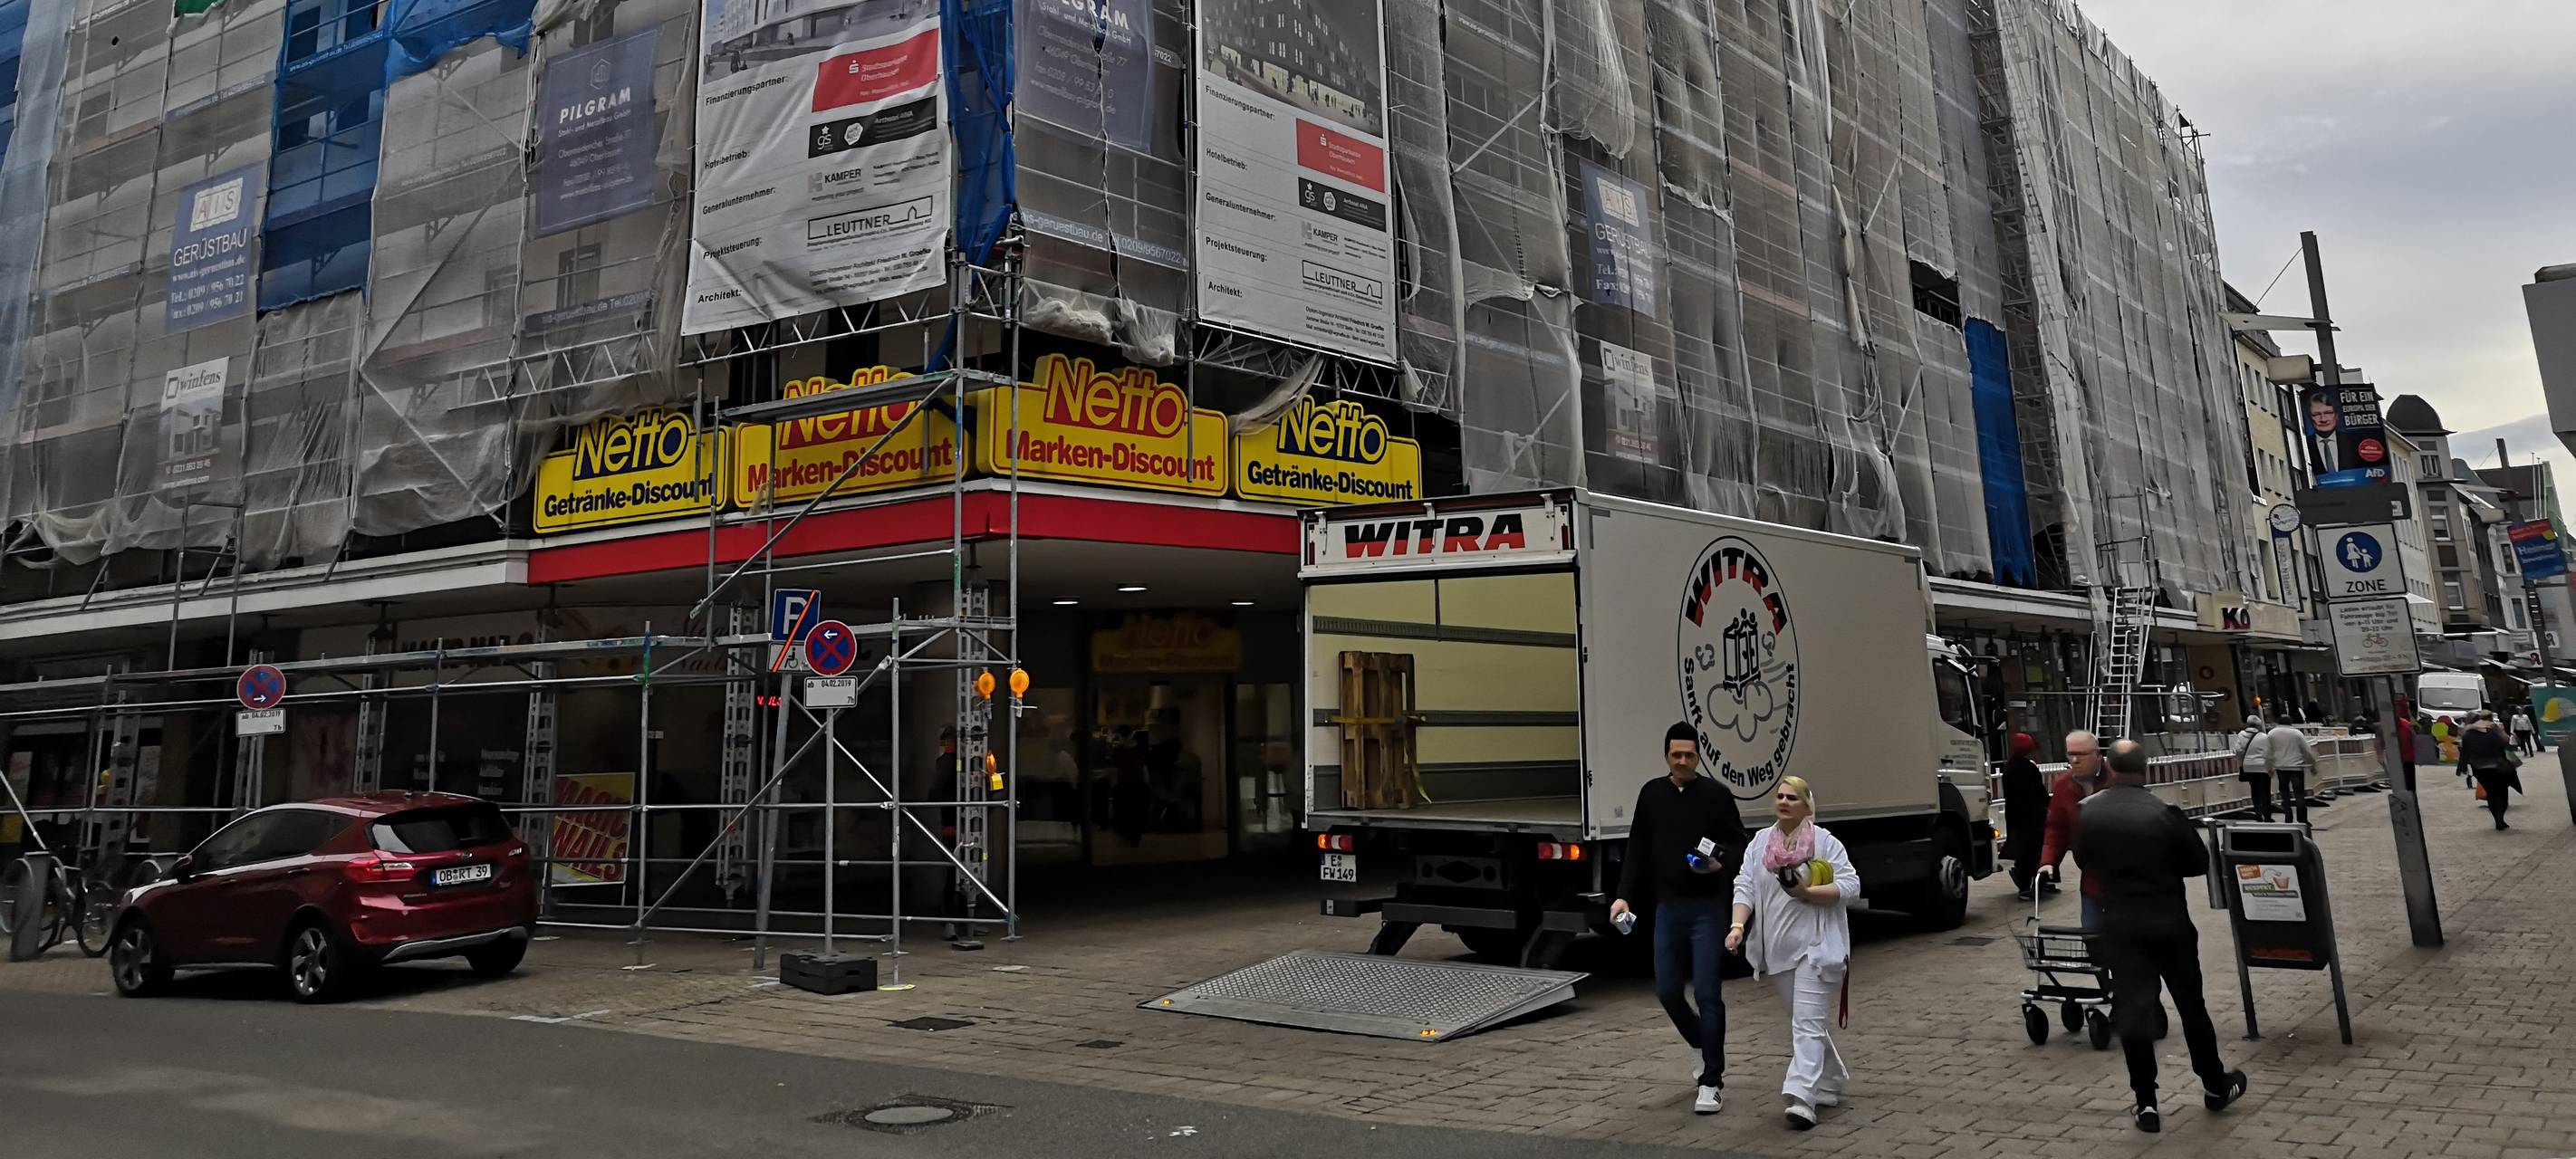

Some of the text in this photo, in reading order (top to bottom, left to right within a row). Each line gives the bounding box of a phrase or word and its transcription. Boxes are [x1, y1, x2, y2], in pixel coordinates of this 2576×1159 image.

[1063, 13, 1076, 23] und
[1111, 31, 1131, 44] GmbH
[706, 76, 788, 106] Finanzierungspartner:
[1206, 85, 1275, 120] Finanzierungspartner:
[559, 87, 631, 124] PILGRAM
[1206, 148, 1247, 170] Hotelbetrieb:
[824, 168, 861, 183] KAMPER
[703, 187, 776, 215] Generalunternehmer:
[1206, 192, 1275, 221] Generalunternehmer:
[827, 215, 891, 236] LEUTTNER
[1312, 228, 1338, 242] KAMPER
[173, 227, 247, 267] GERÜSTBAU
[703, 236, 762, 259] Projektsteuerung:
[1206, 236, 1267, 263] Projektsteuerung:
[1208, 281, 1243, 297] Architekt:
[1315, 271, 1356, 291] LEUTTNER
[697, 289, 742, 303] Architekt:
[179, 369, 222, 391] winfens
[1045, 359, 1184, 436] Netto
[2340, 389, 2375, 403] FÜR EIN
[1278, 398, 1386, 463] Netto
[2344, 413, 2379, 426] BÜRGER
[574, 409, 689, 479] Netto
[1005, 429, 1216, 482] Marken-Discount
[747, 437, 953, 493] Marken-Discount
[2366, 469, 2385, 478] AfD
[1247, 460, 1414, 500] Getränke-Discount
[544, 473, 714, 518] Getränke-Discount
[1345, 513, 1525, 559] WITRA
[1685, 547, 1788, 636] WITRA
[2346, 579, 2387, 593] ZONE
[822, 679, 851, 687] 04.02.2019
[1684, 656, 1795, 788] Sanft auf den Weg gebracht
[552, 821, 628, 880] NAILS
[1331, 855, 1336, 867] E
[439, 866, 487, 882] OB RT 39
[1323, 867, 1354, 880] FW 149
